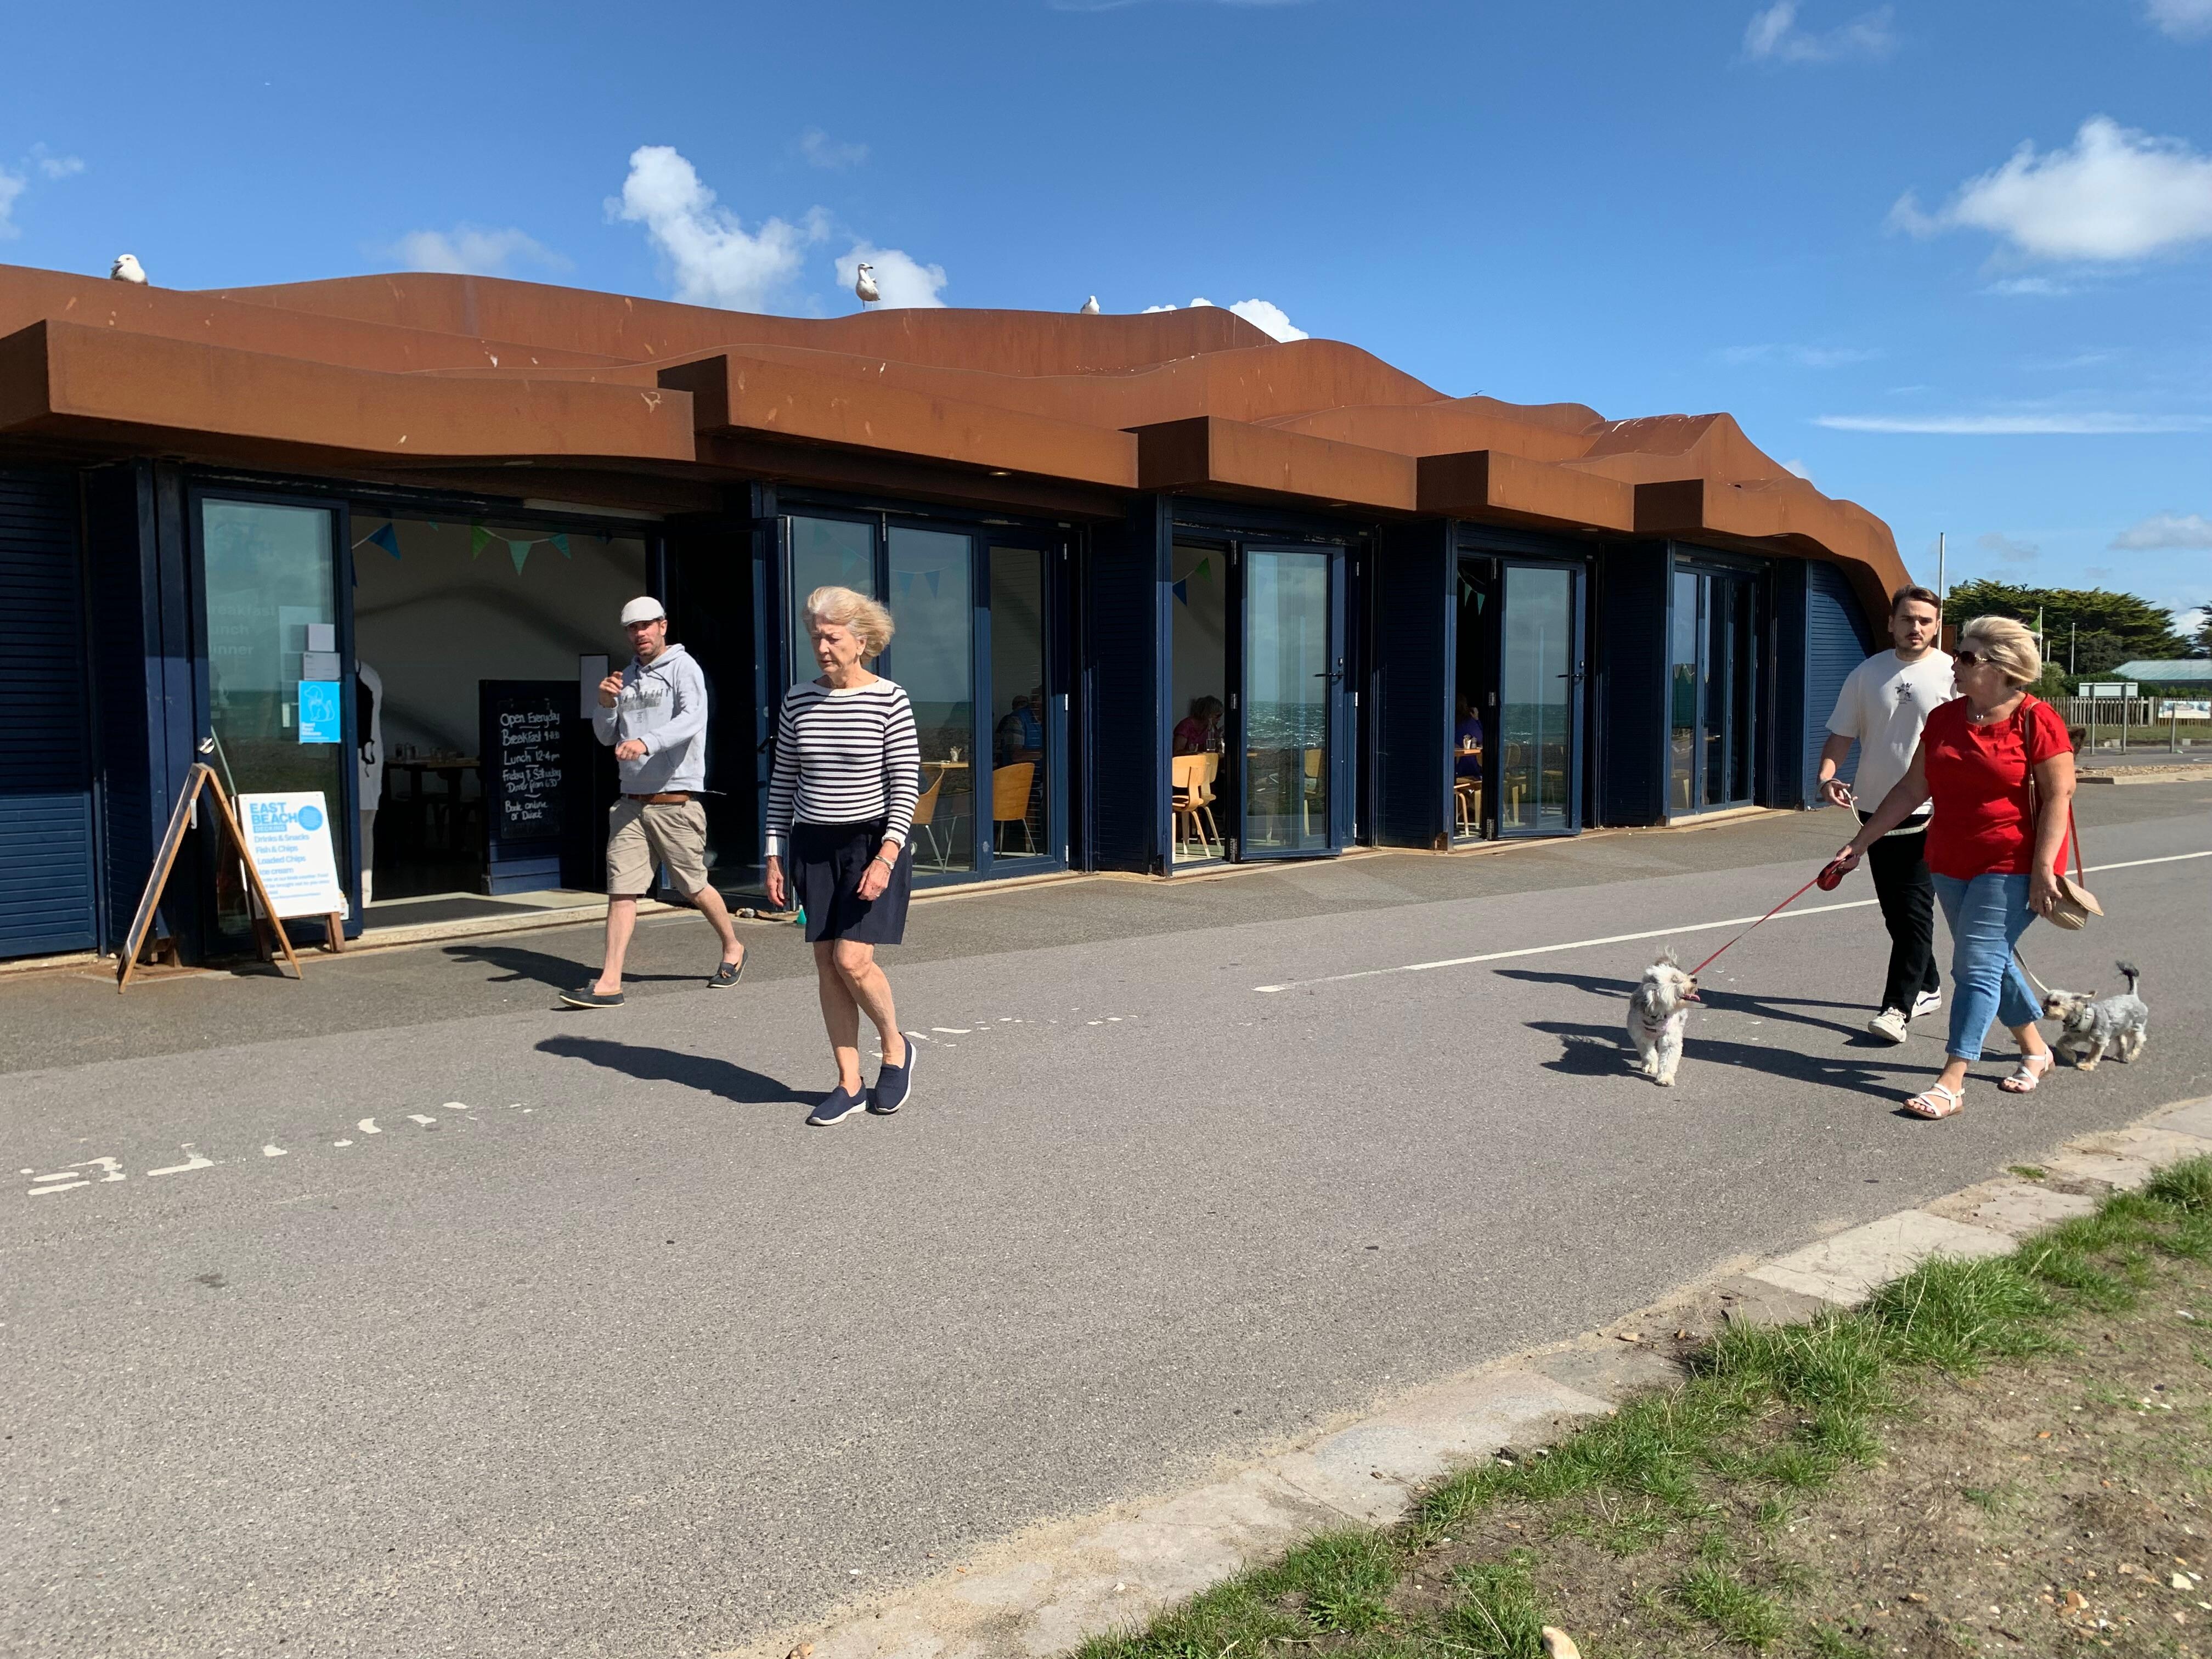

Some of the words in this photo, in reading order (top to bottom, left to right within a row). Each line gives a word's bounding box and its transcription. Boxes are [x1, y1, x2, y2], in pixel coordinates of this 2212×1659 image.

[500, 713, 525, 728] Open
[528, 709, 560, 728] Everyday
[504, 751, 532, 765] Lunch
[503, 769, 526, 785] Friday
[533, 768, 562, 781] Saturday
[529, 780, 544, 793] from
[250, 802, 287, 814] EAST
[505, 800, 522, 812] Book
[524, 800, 548, 810] online
[251, 812, 298, 824] BEACH
[511, 812, 518, 821] or
[278, 845, 298, 853] Chips
[257, 856, 285, 865] Loaded
[285, 855, 306, 864] Chips
